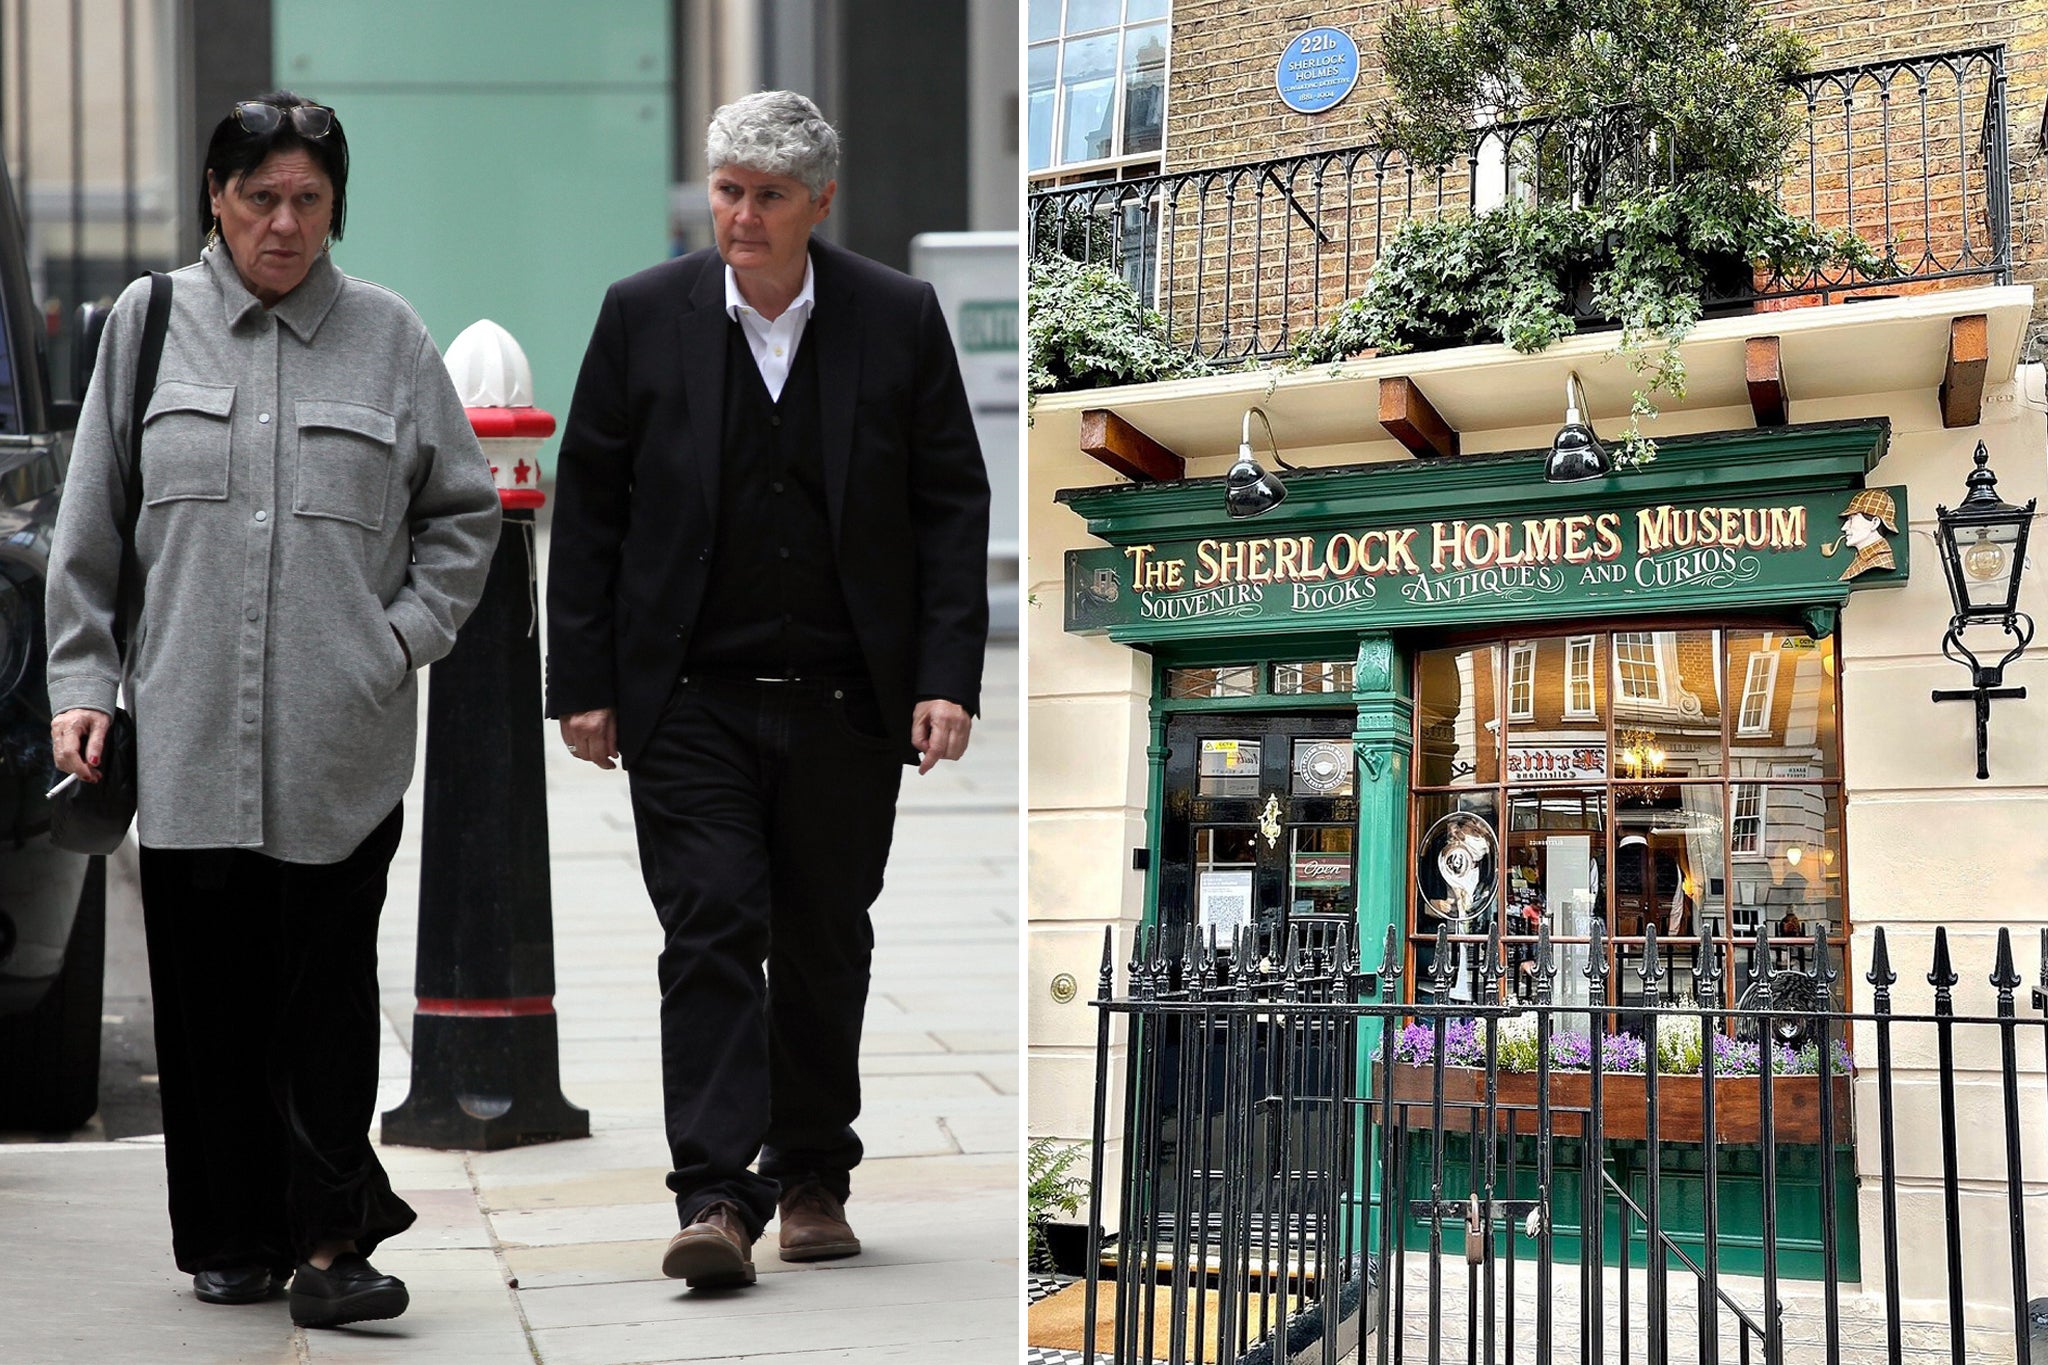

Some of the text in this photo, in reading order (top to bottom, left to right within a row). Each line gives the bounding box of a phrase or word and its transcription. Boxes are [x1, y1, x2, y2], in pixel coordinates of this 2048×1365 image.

[1300, 33, 1337, 54] 221b
[1288, 53, 1346, 71] SHERLOCK
[1295, 66, 1340, 81] HOLMES
[1283, 77, 1351, 92] CONSULTING DETECTIVE
[1124, 505, 1808, 592] THE SHERLOCK HOLMES MUSEUM
[1140, 547, 1737, 619] SOUVENIRS BOOKS ANTIQUES AND CURIOS
[1304, 860, 1341, 877] Open
